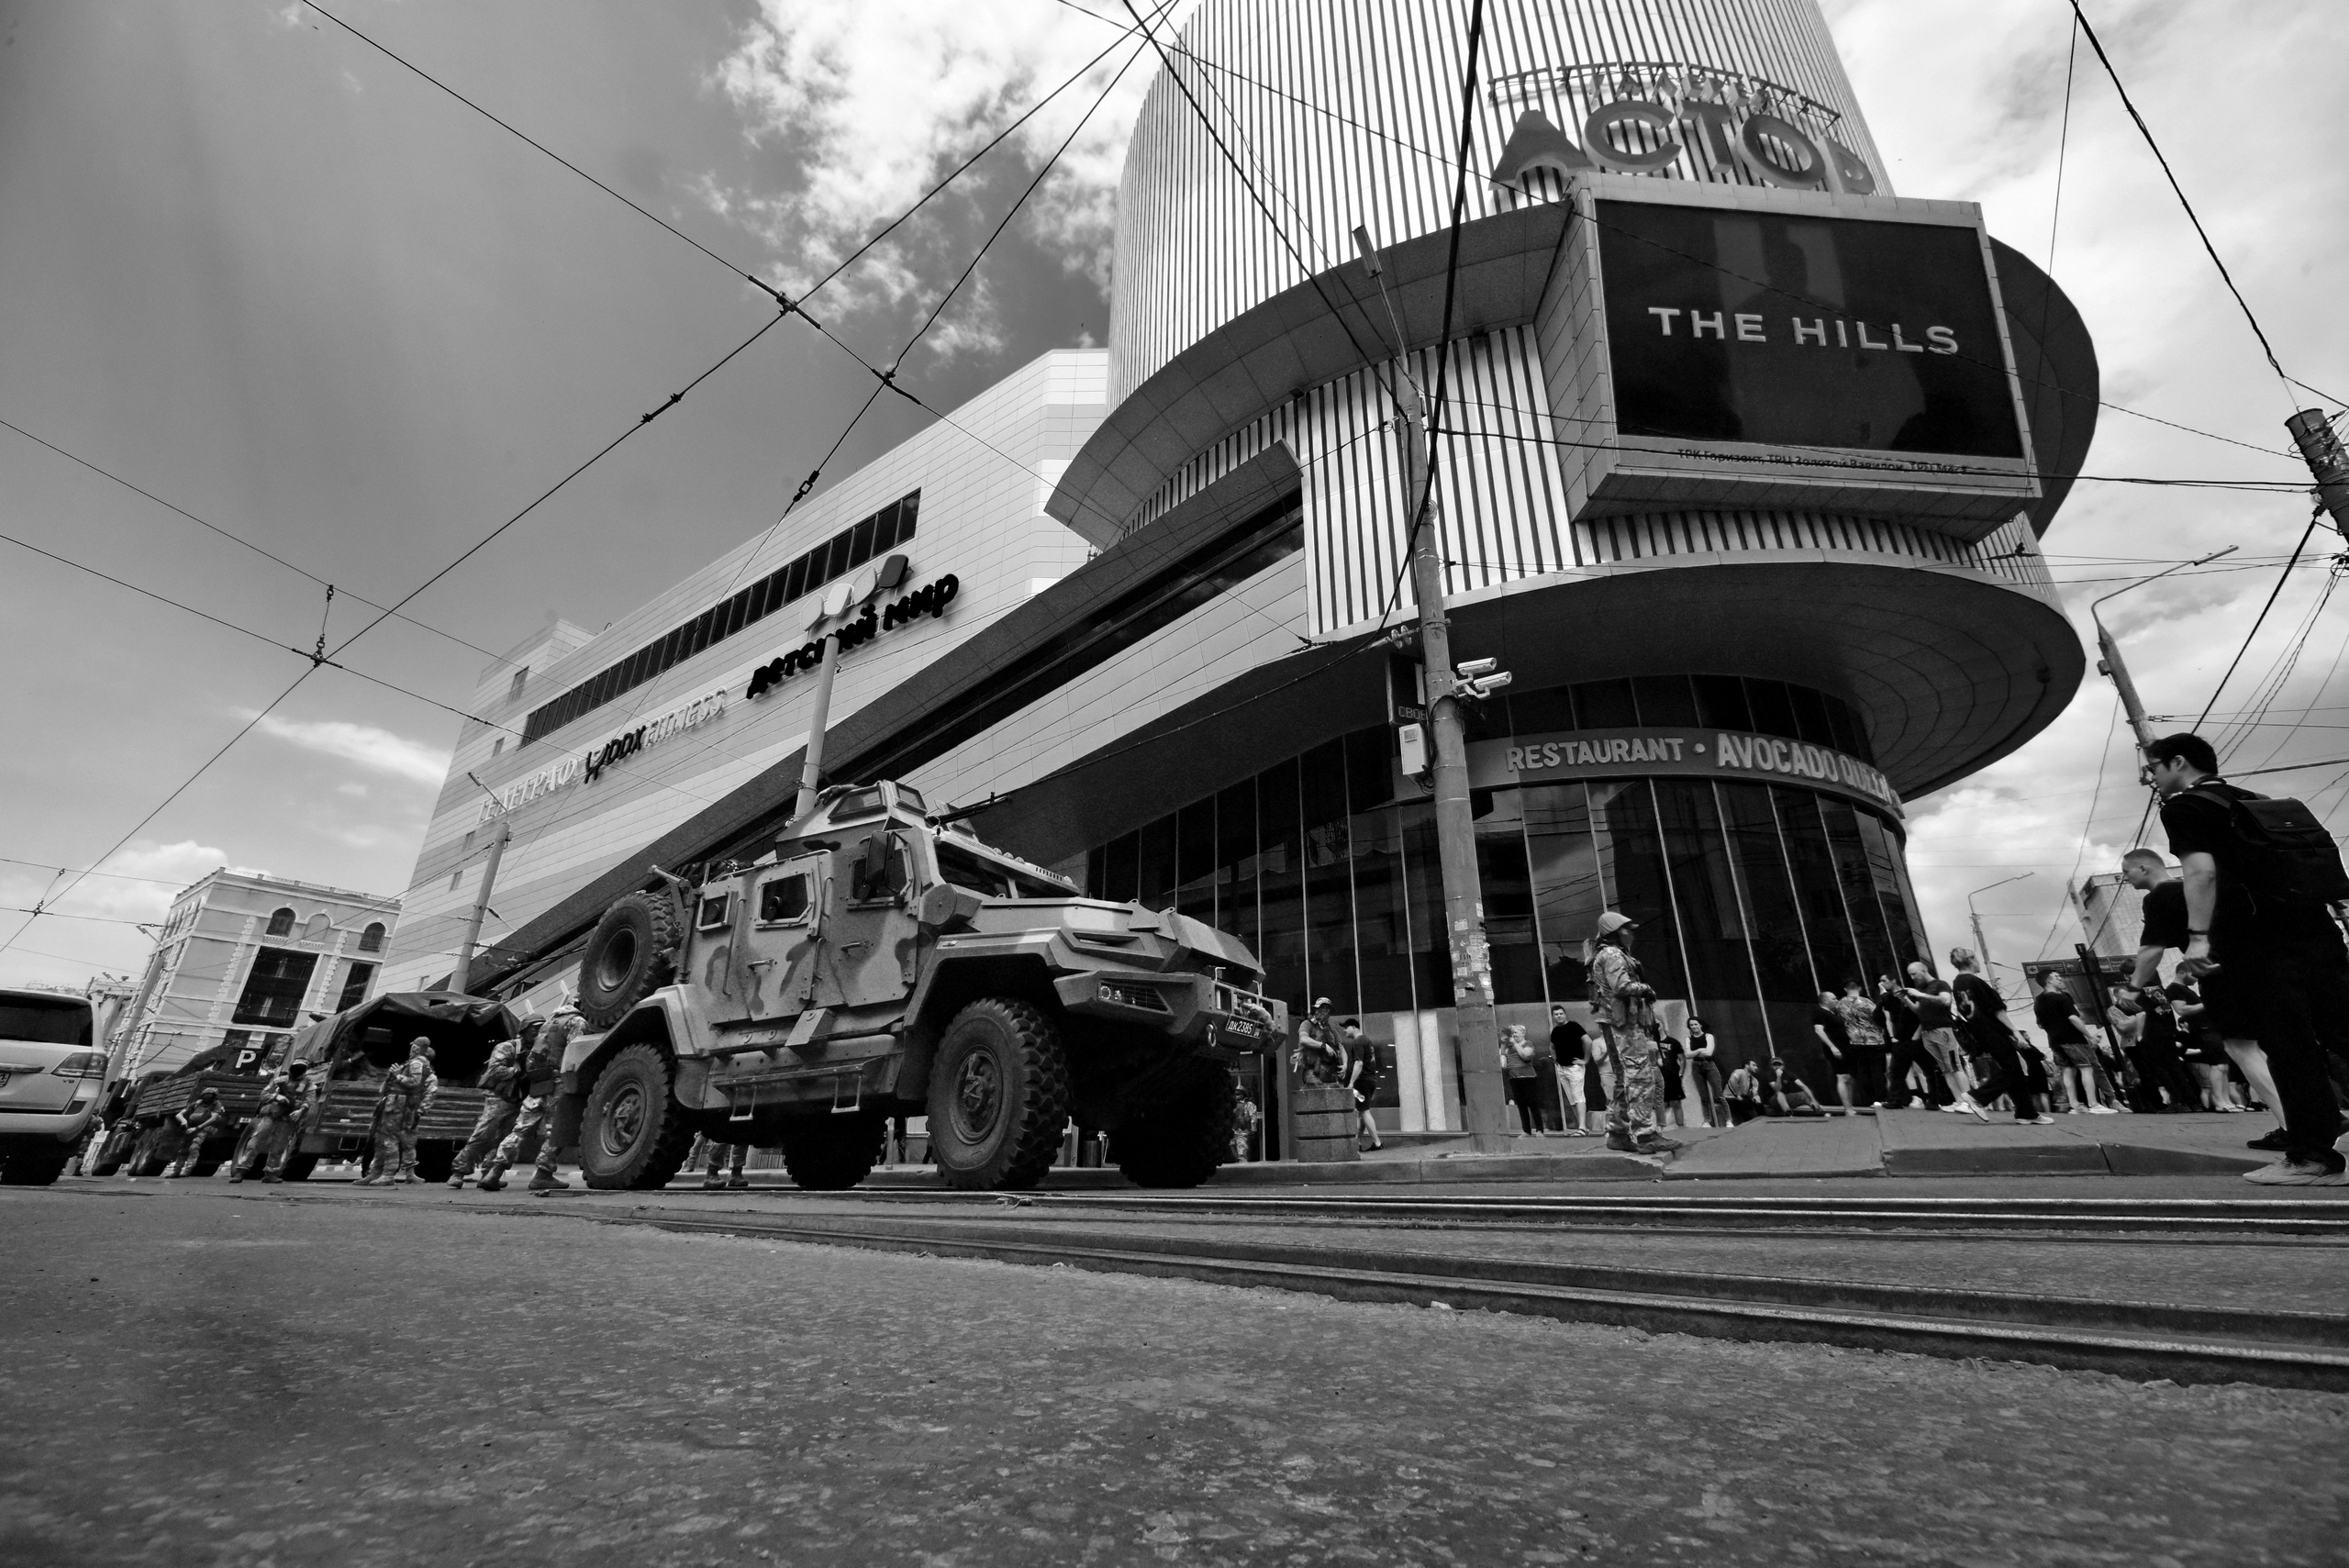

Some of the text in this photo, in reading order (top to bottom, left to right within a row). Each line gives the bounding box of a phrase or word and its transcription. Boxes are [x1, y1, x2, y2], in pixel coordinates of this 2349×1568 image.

[1648, 306, 1959, 355] THE HILLS
[645, 685, 727, 748] FITNESS
[1506, 737, 1684, 772] RESTAURANT
[1717, 733, 1839, 783] AVOCADO
[235, 1050, 257, 1069] P
